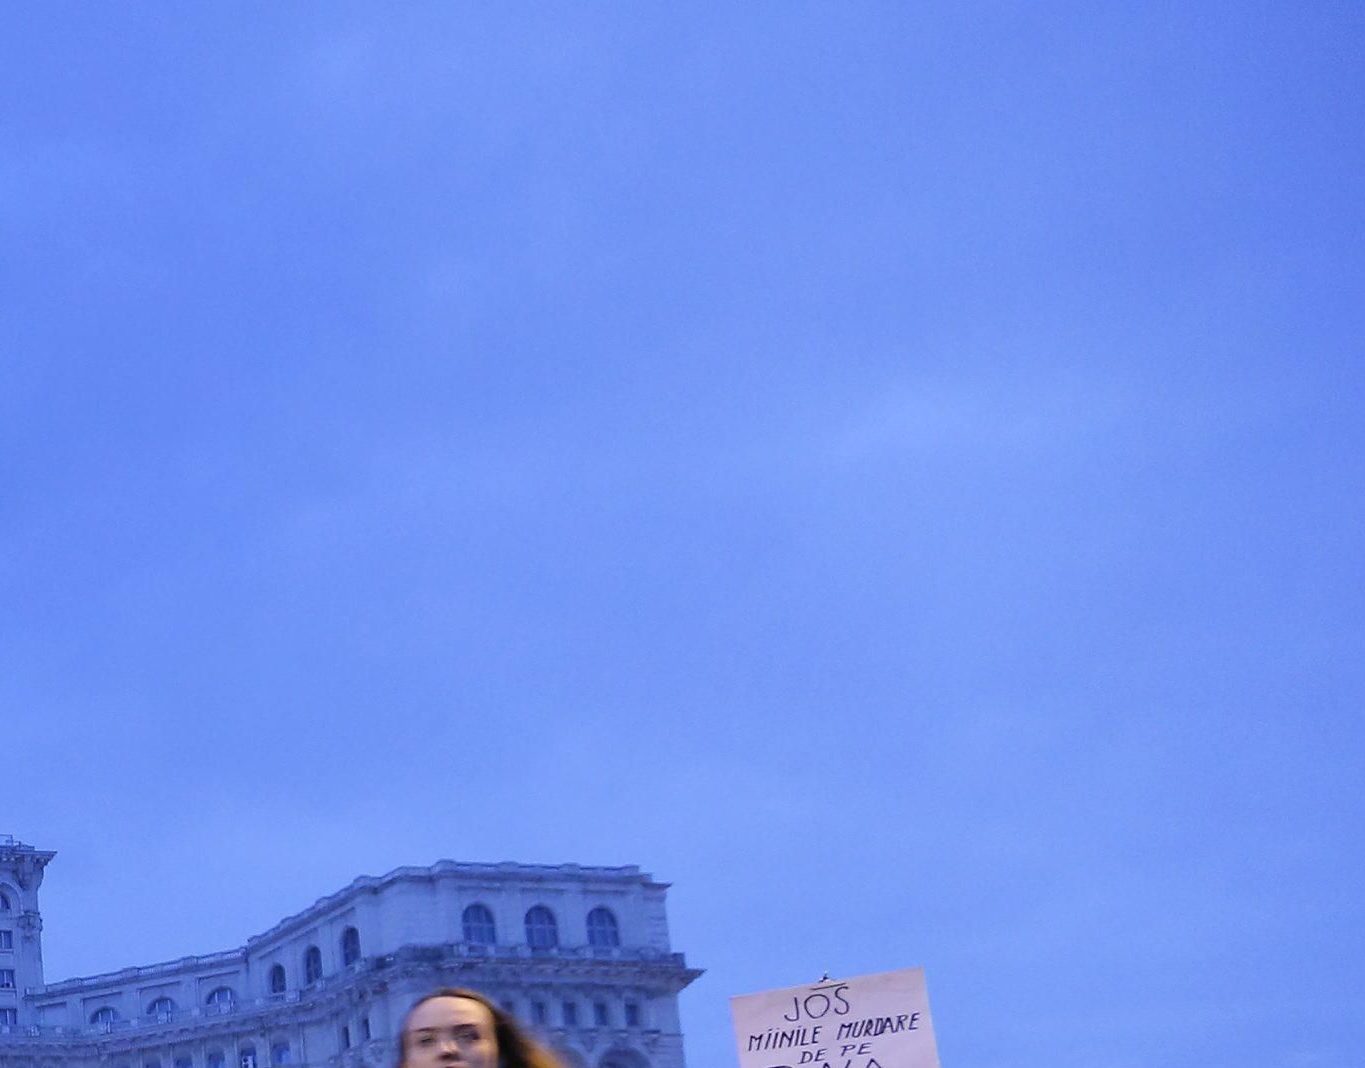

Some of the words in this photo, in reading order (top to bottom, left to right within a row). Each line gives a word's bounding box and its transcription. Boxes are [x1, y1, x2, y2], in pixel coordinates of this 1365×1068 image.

[836, 1012, 920, 1041] MURDARE
[797, 1048, 828, 1065] DE
[840, 1042, 872, 1057] PE
